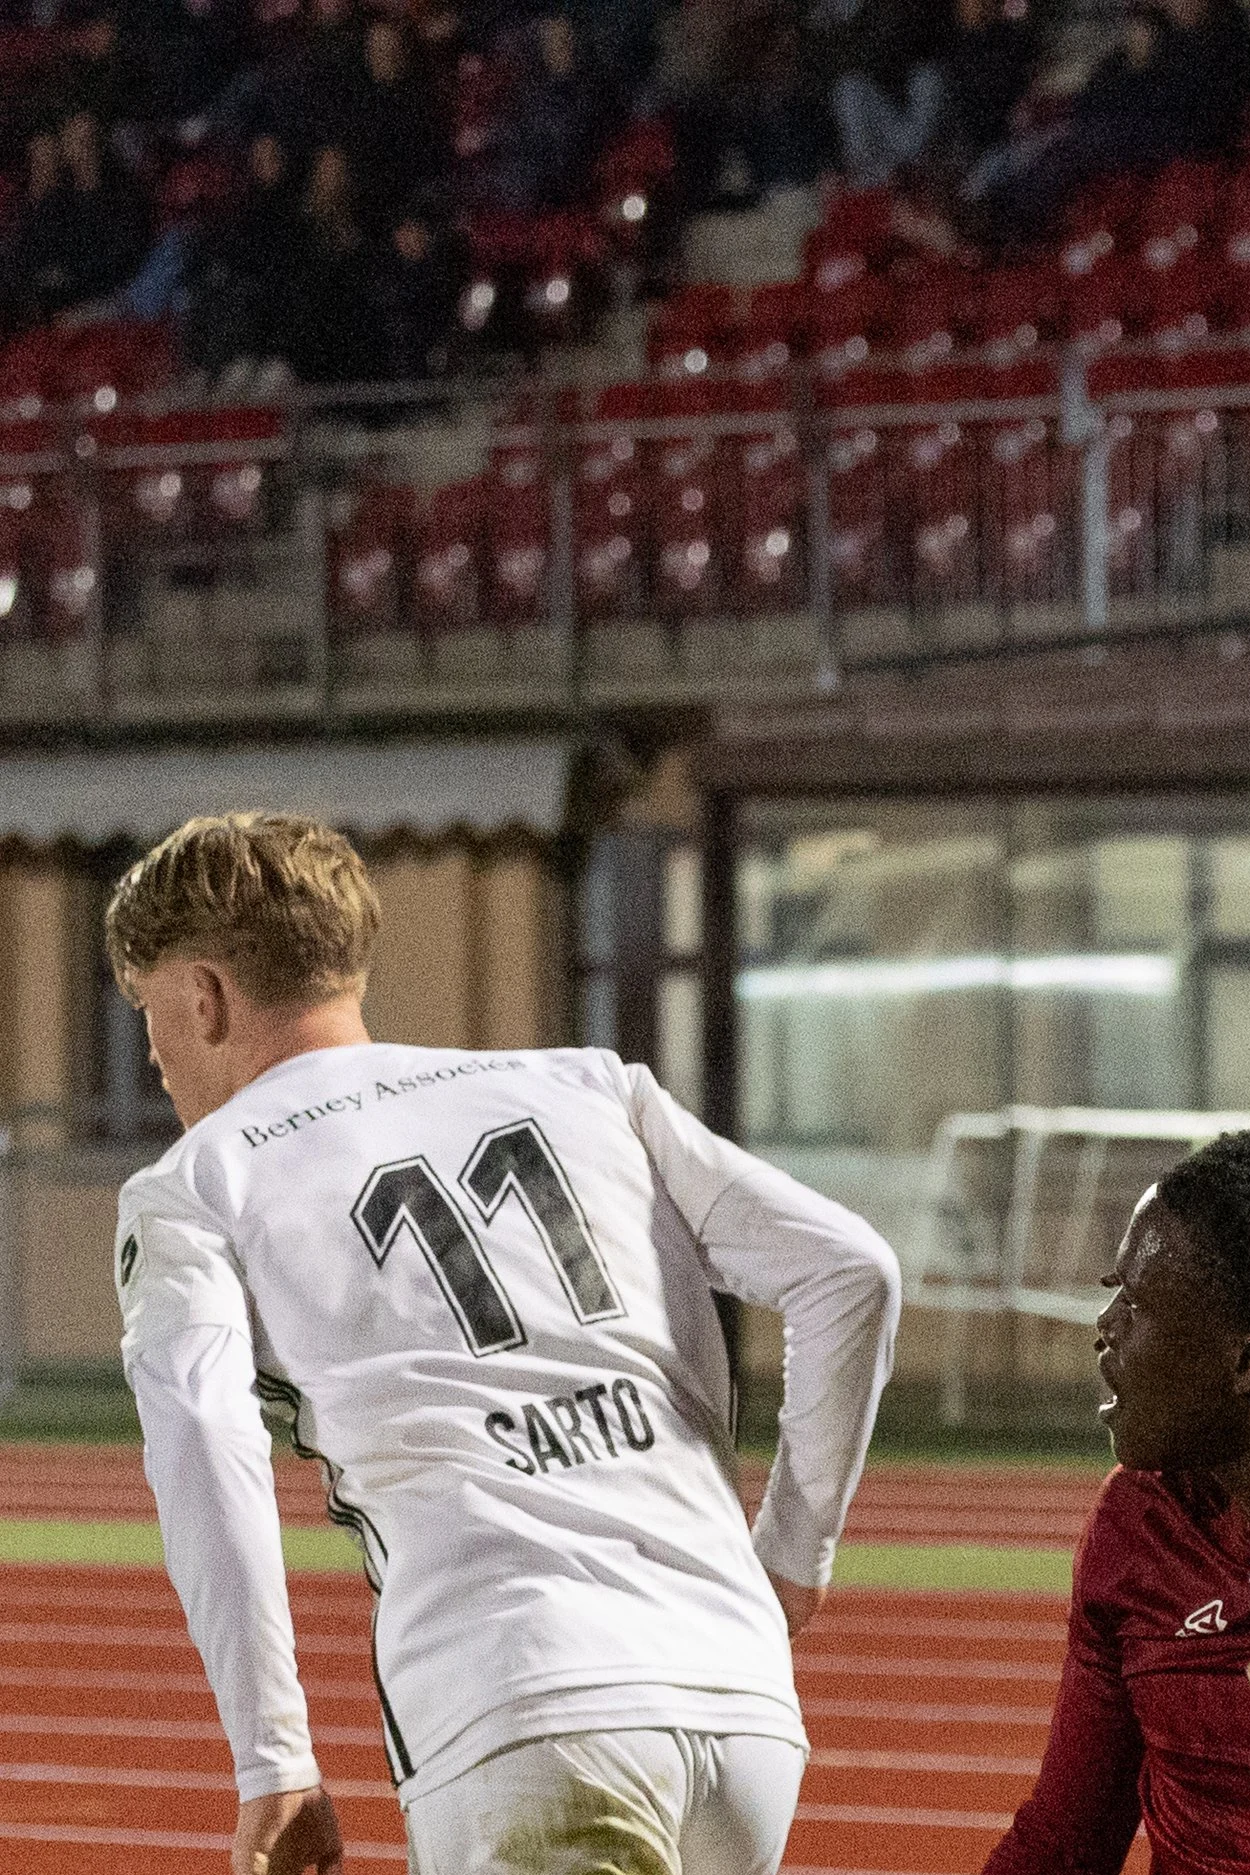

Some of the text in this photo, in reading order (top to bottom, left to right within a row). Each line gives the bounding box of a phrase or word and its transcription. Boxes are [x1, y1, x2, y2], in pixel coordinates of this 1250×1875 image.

[239, 1091, 364, 1148] Berney
[350, 1116, 627, 1358] 11
[484, 1378, 656, 1476] SARTO
